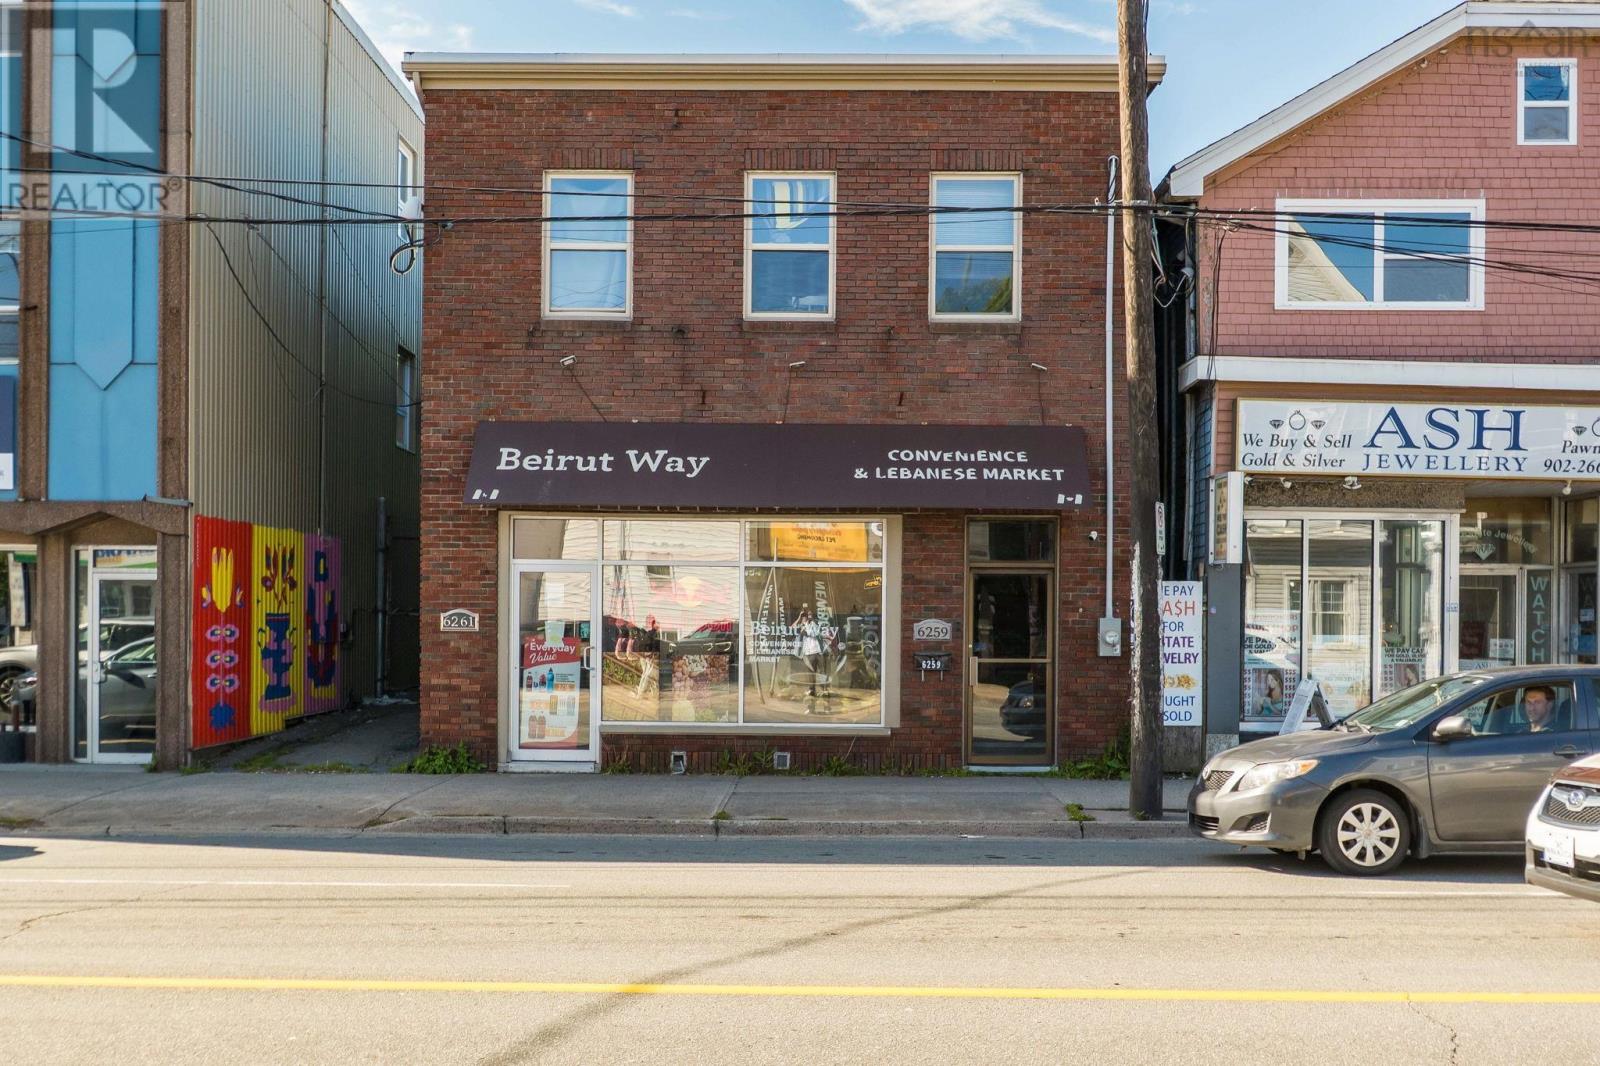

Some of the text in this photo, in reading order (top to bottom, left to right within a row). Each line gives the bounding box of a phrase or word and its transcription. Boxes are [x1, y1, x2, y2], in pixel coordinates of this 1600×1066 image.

[1363, 405, 1528, 451] ASH
[1243, 433, 1353, 450] We Buy & Sell
[496, 447, 710, 478] Beirut Way
[887, 449, 1028, 462] CONVENIENCE
[1242, 453, 1346, 468] Gold & Silver
[1362, 453, 1527, 472] JEWELLERY
[854, 467, 1065, 481] & LEBANESE MARKET
[1173, 585, 1194, 596] PAY
[1163, 600, 1196, 618] A$H
[443, 615, 477, 629] 6261
[1530, 576, 1548, 662] WATCH
[751, 620, 839, 640] Beirut Way
[917, 626, 948, 638] 6259
[921, 660, 941, 669] 6259
[1165, 696, 1196, 707] UGHT
[1163, 711, 1193, 722] SOLD
